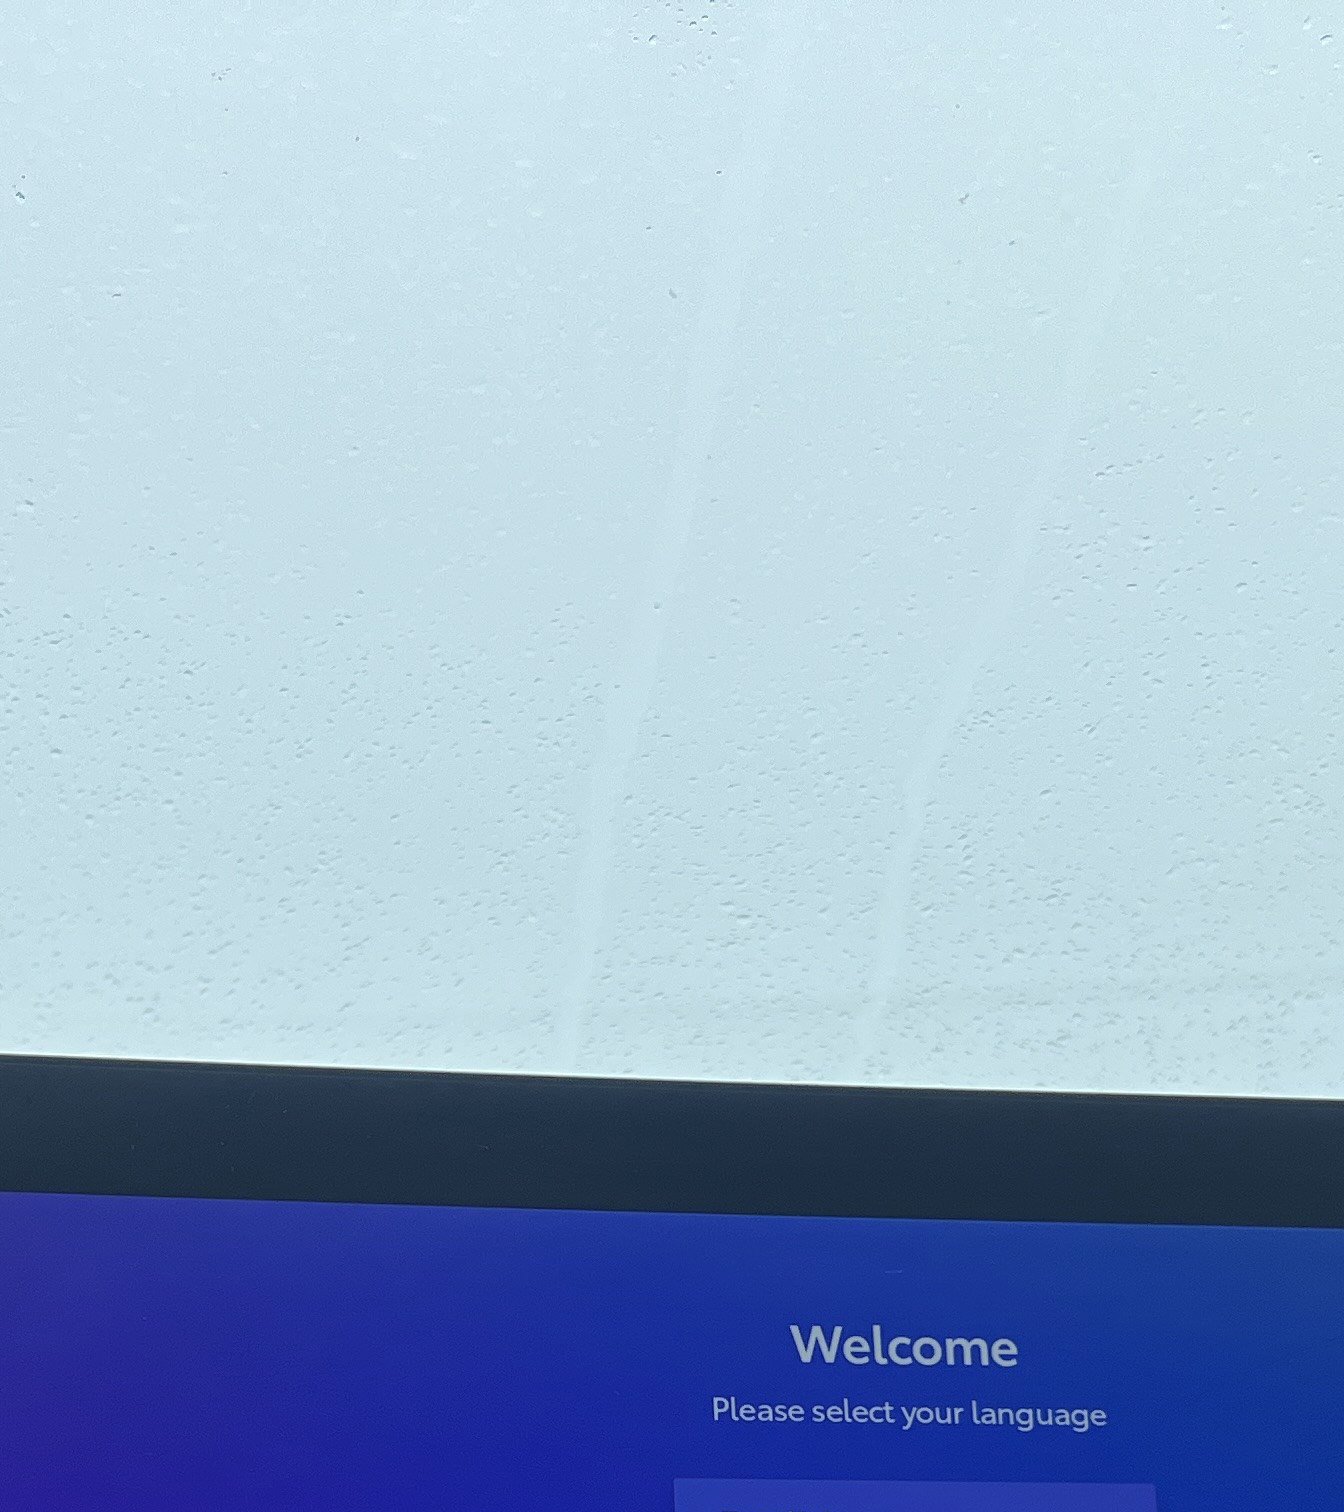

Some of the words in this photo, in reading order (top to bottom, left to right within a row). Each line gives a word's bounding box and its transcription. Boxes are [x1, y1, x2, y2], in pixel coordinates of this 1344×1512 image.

[790, 1324, 1019, 1367] Welcome
[712, 1396, 805, 1423] Please
[812, 1398, 895, 1424] select
[901, 1404, 964, 1430] your
[971, 1400, 1108, 1432] language
